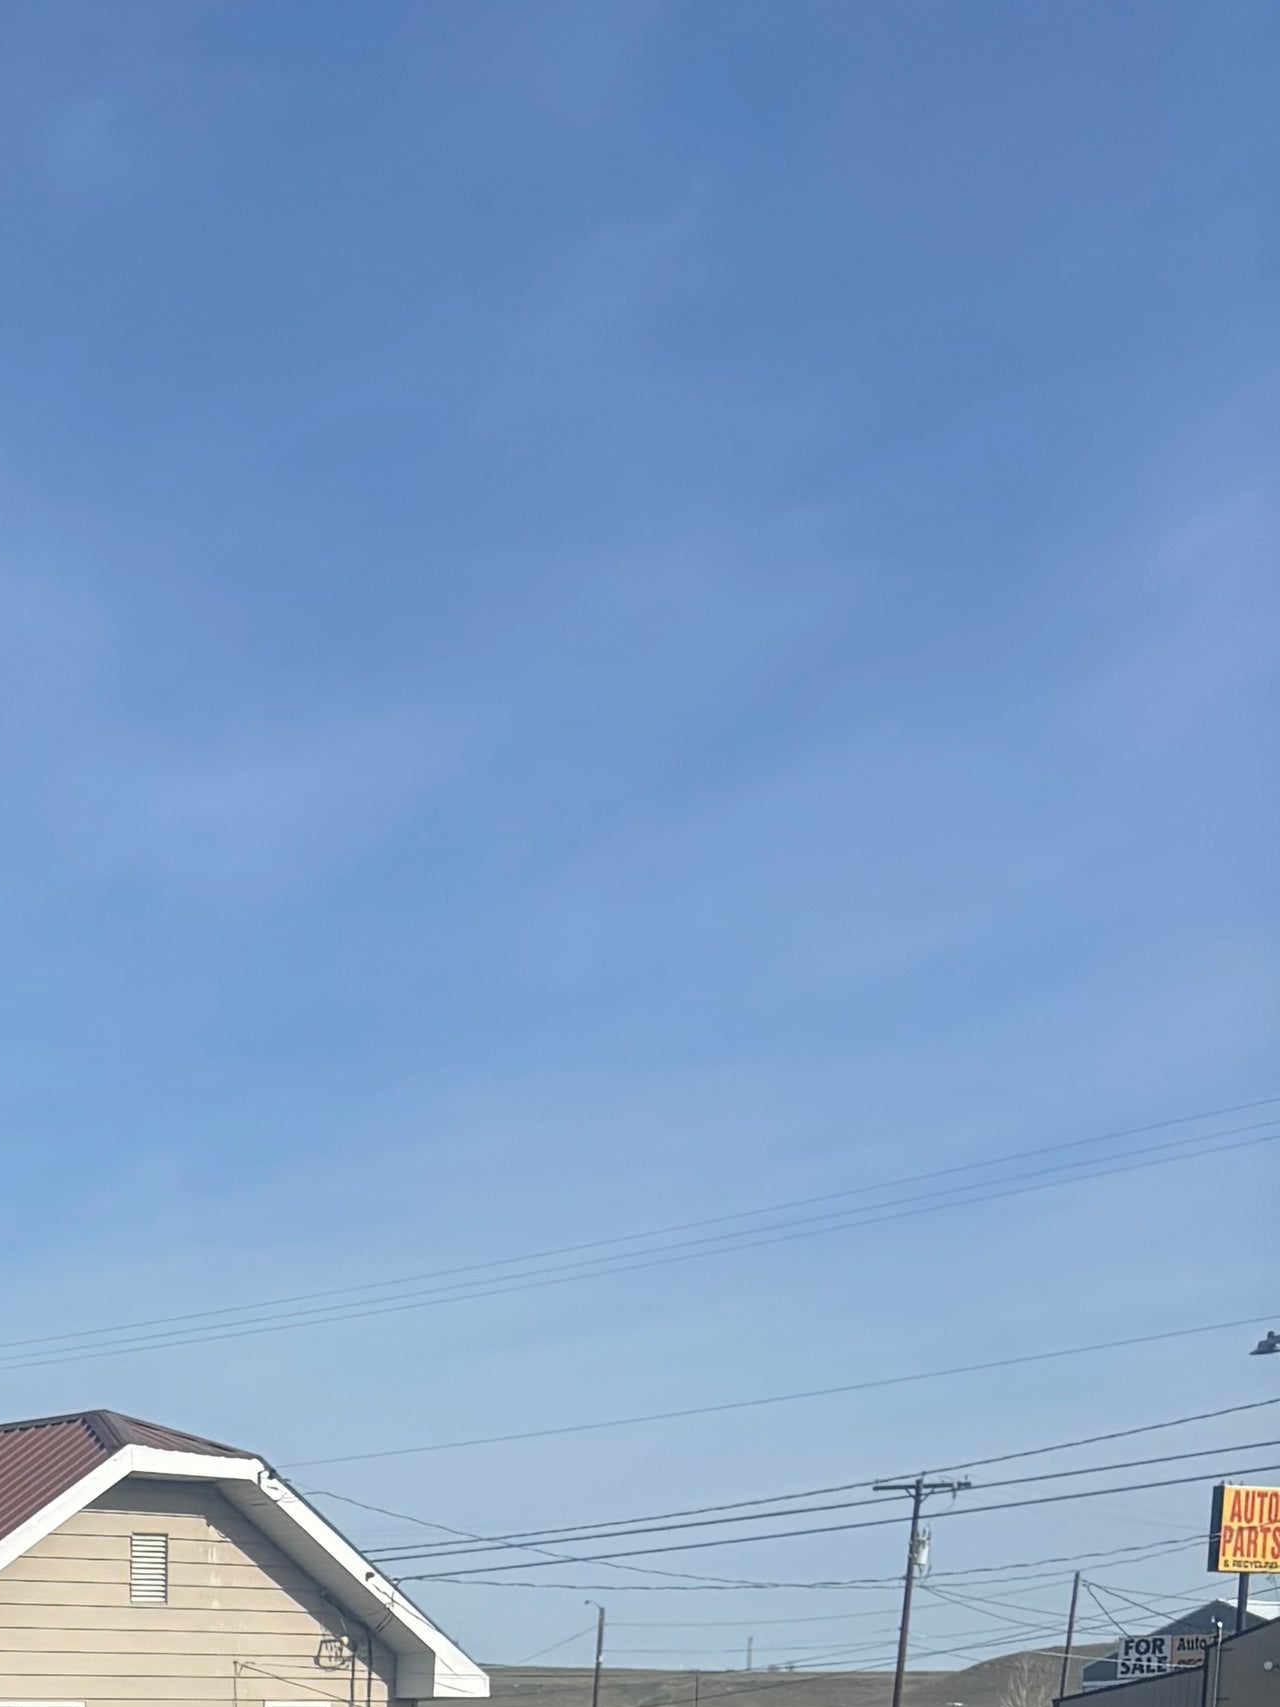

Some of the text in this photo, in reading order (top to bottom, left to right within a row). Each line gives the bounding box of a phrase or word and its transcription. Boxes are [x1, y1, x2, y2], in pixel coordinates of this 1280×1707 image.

[1229, 1489, 1279, 1524] AUTO
[1220, 1525, 1280, 1560] PARTS
[1123, 1637, 1166, 1656] FOR
[1120, 1656, 1168, 1675] SALE
